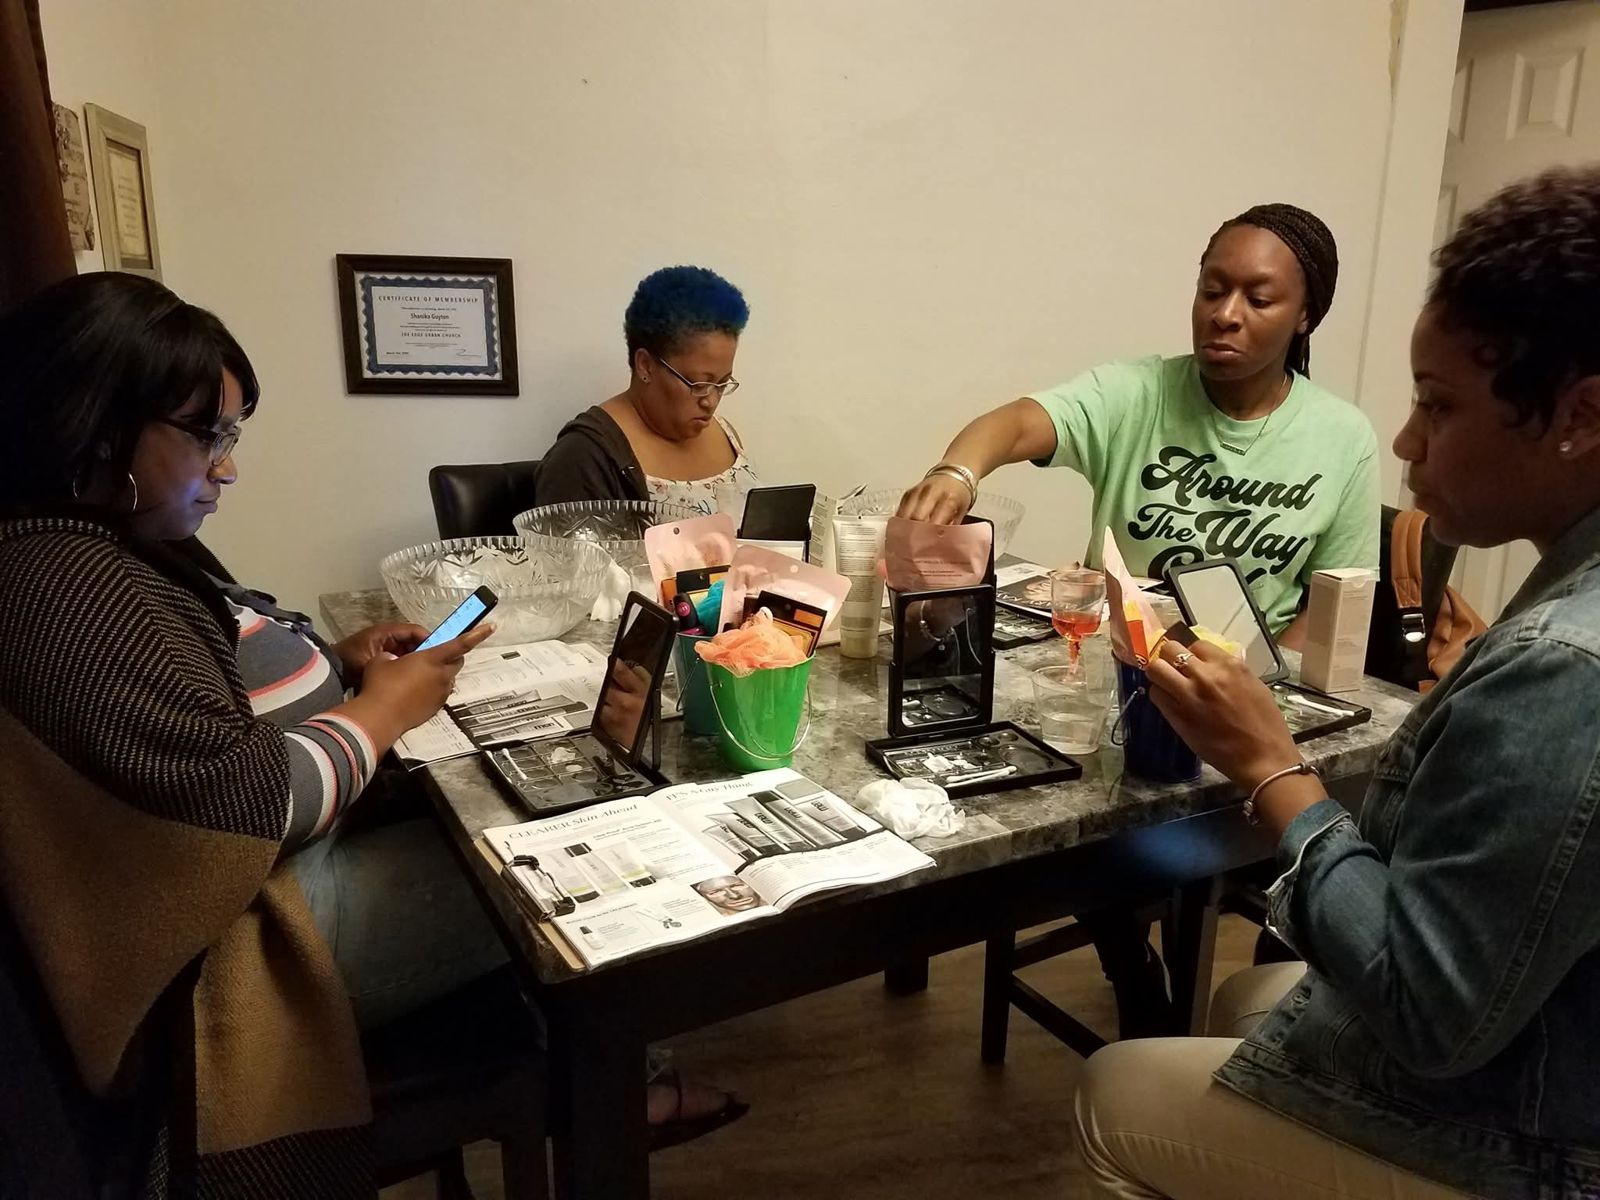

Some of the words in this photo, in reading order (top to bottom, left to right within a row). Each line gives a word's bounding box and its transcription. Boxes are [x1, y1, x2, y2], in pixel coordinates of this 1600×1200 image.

[1141, 446, 1323, 510] Around
[1127, 503, 1198, 543] The
[1194, 509, 1309, 575] Way
[509, 822, 572, 839] CLEARER
[573, 814, 600, 826] Skin
[601, 803, 639, 819] Ahead
